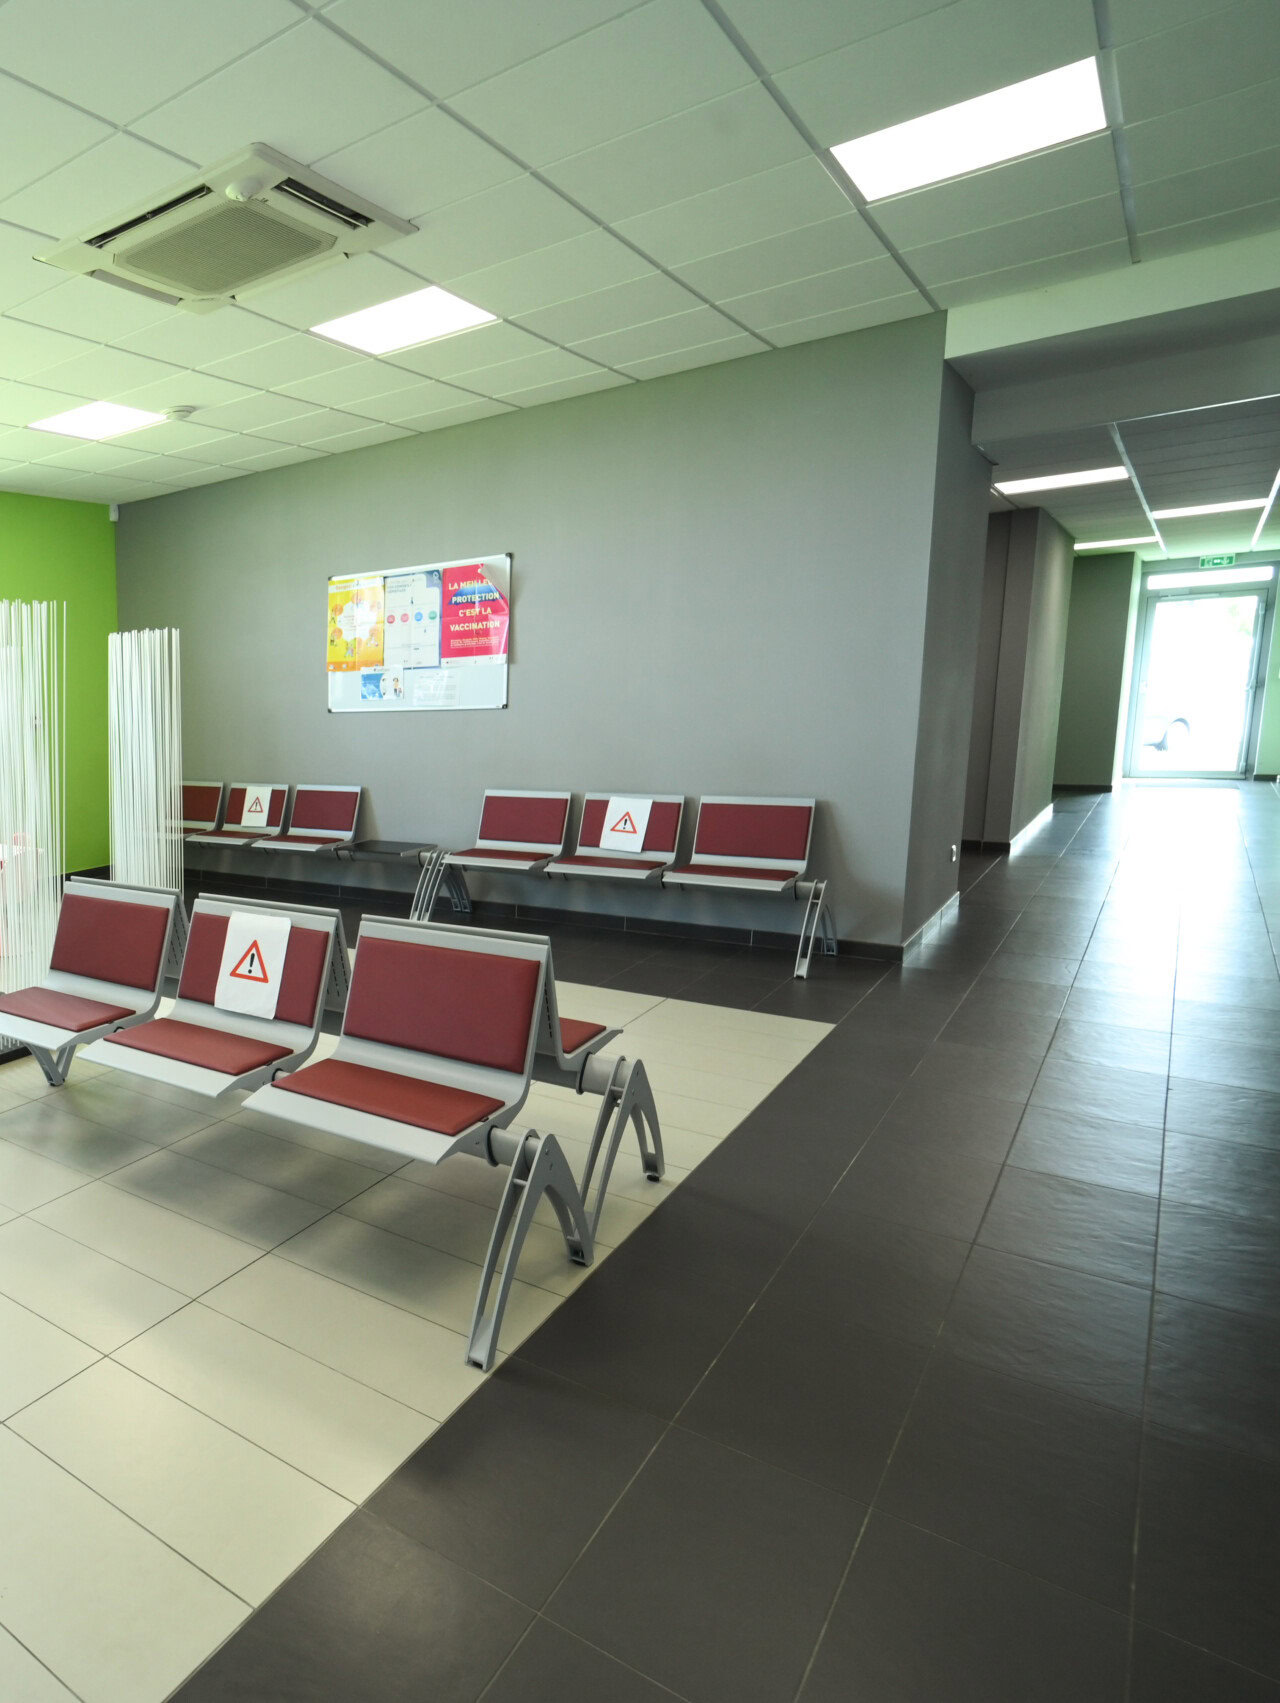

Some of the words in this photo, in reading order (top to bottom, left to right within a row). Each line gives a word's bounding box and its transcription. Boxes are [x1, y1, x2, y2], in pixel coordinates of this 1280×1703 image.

[448, 582, 459, 590] LA
[460, 578, 492, 588] MEILLE
[451, 592, 500, 603] PROTECTION
[458, 608, 480, 617] C'EST
[481, 607, 492, 615] LA
[450, 620, 500, 632] VACCINATION
